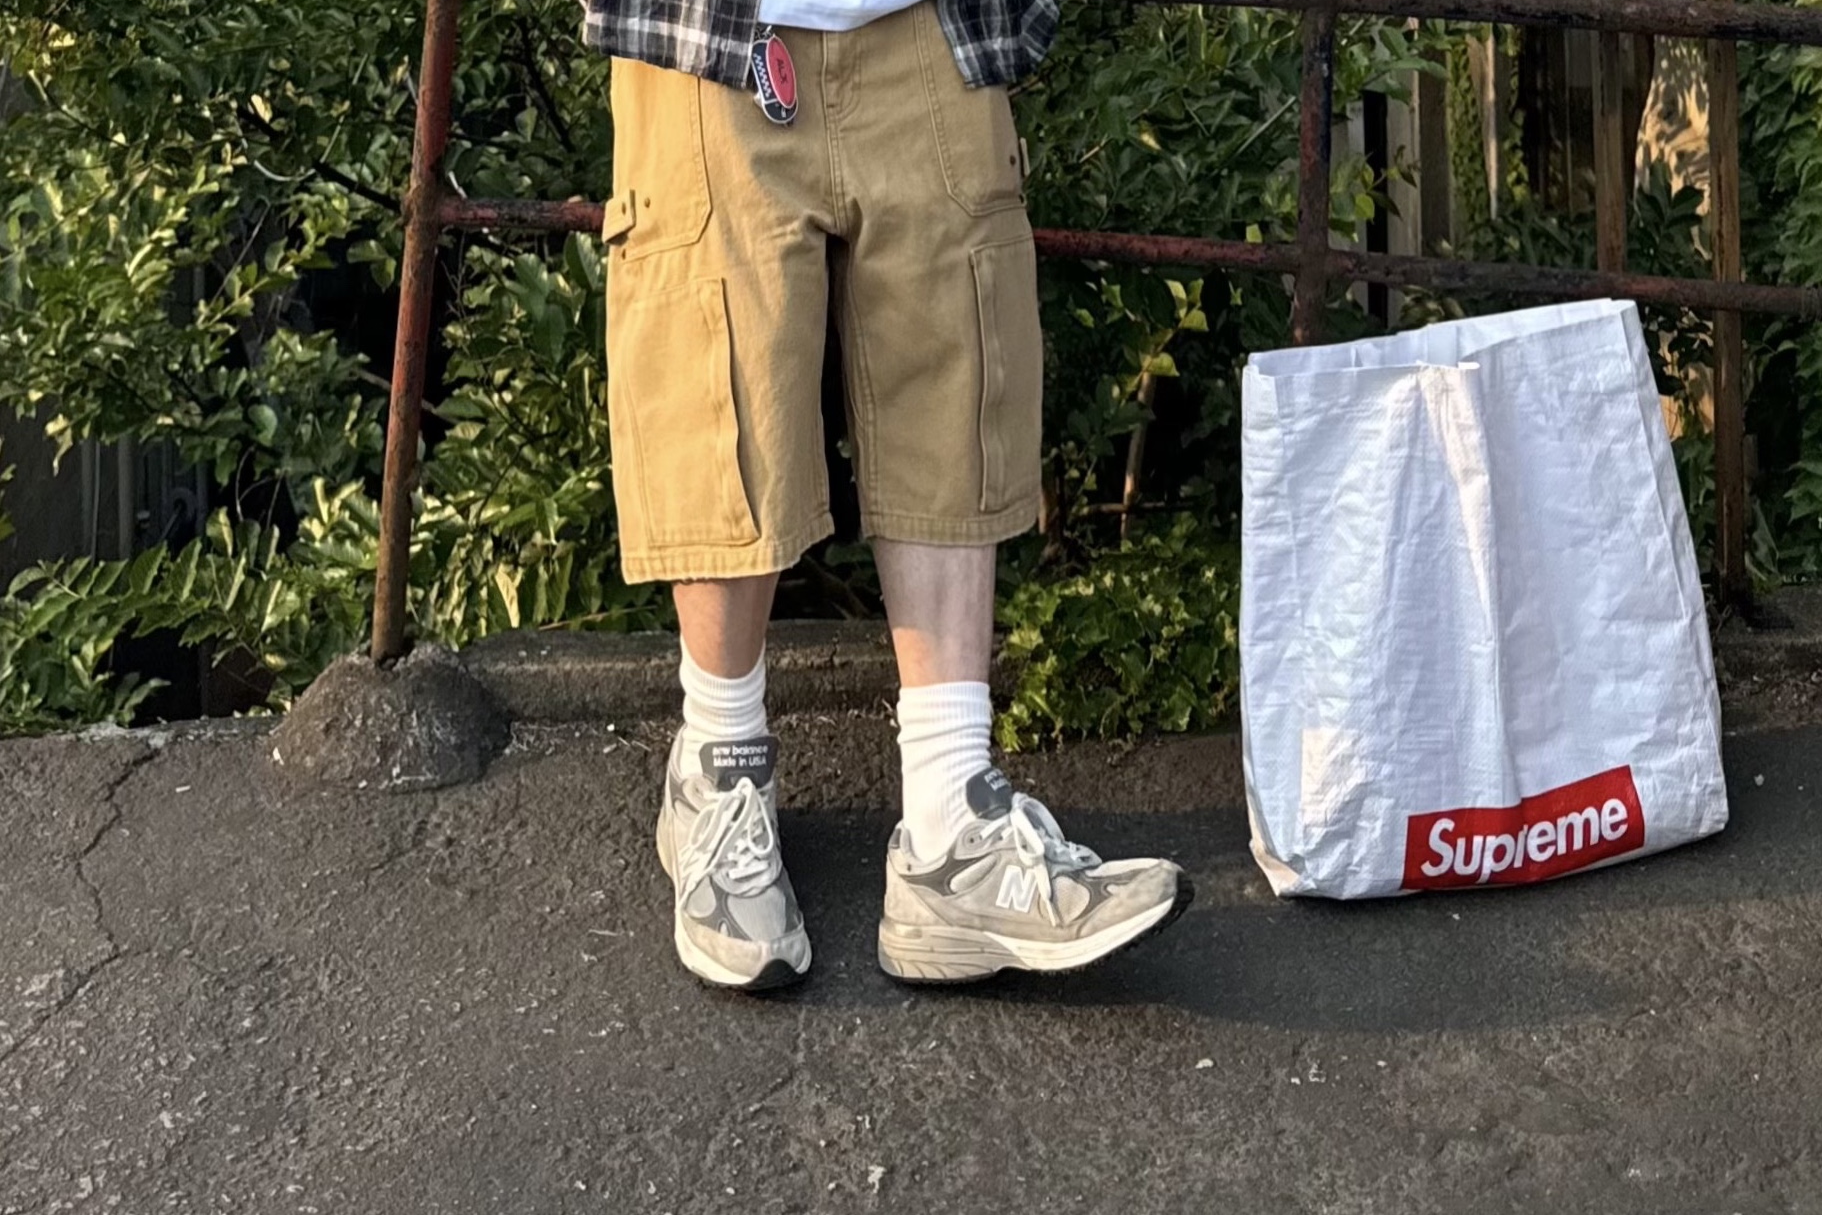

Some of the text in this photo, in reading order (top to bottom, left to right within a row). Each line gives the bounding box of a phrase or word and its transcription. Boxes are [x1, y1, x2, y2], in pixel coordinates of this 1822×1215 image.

[713, 756, 736, 767] Made
[748, 755, 766, 766] USA
[732, 745, 768, 756] balance
[1421, 798, 1628, 884] Supreme
[995, 865, 1036, 913] N
